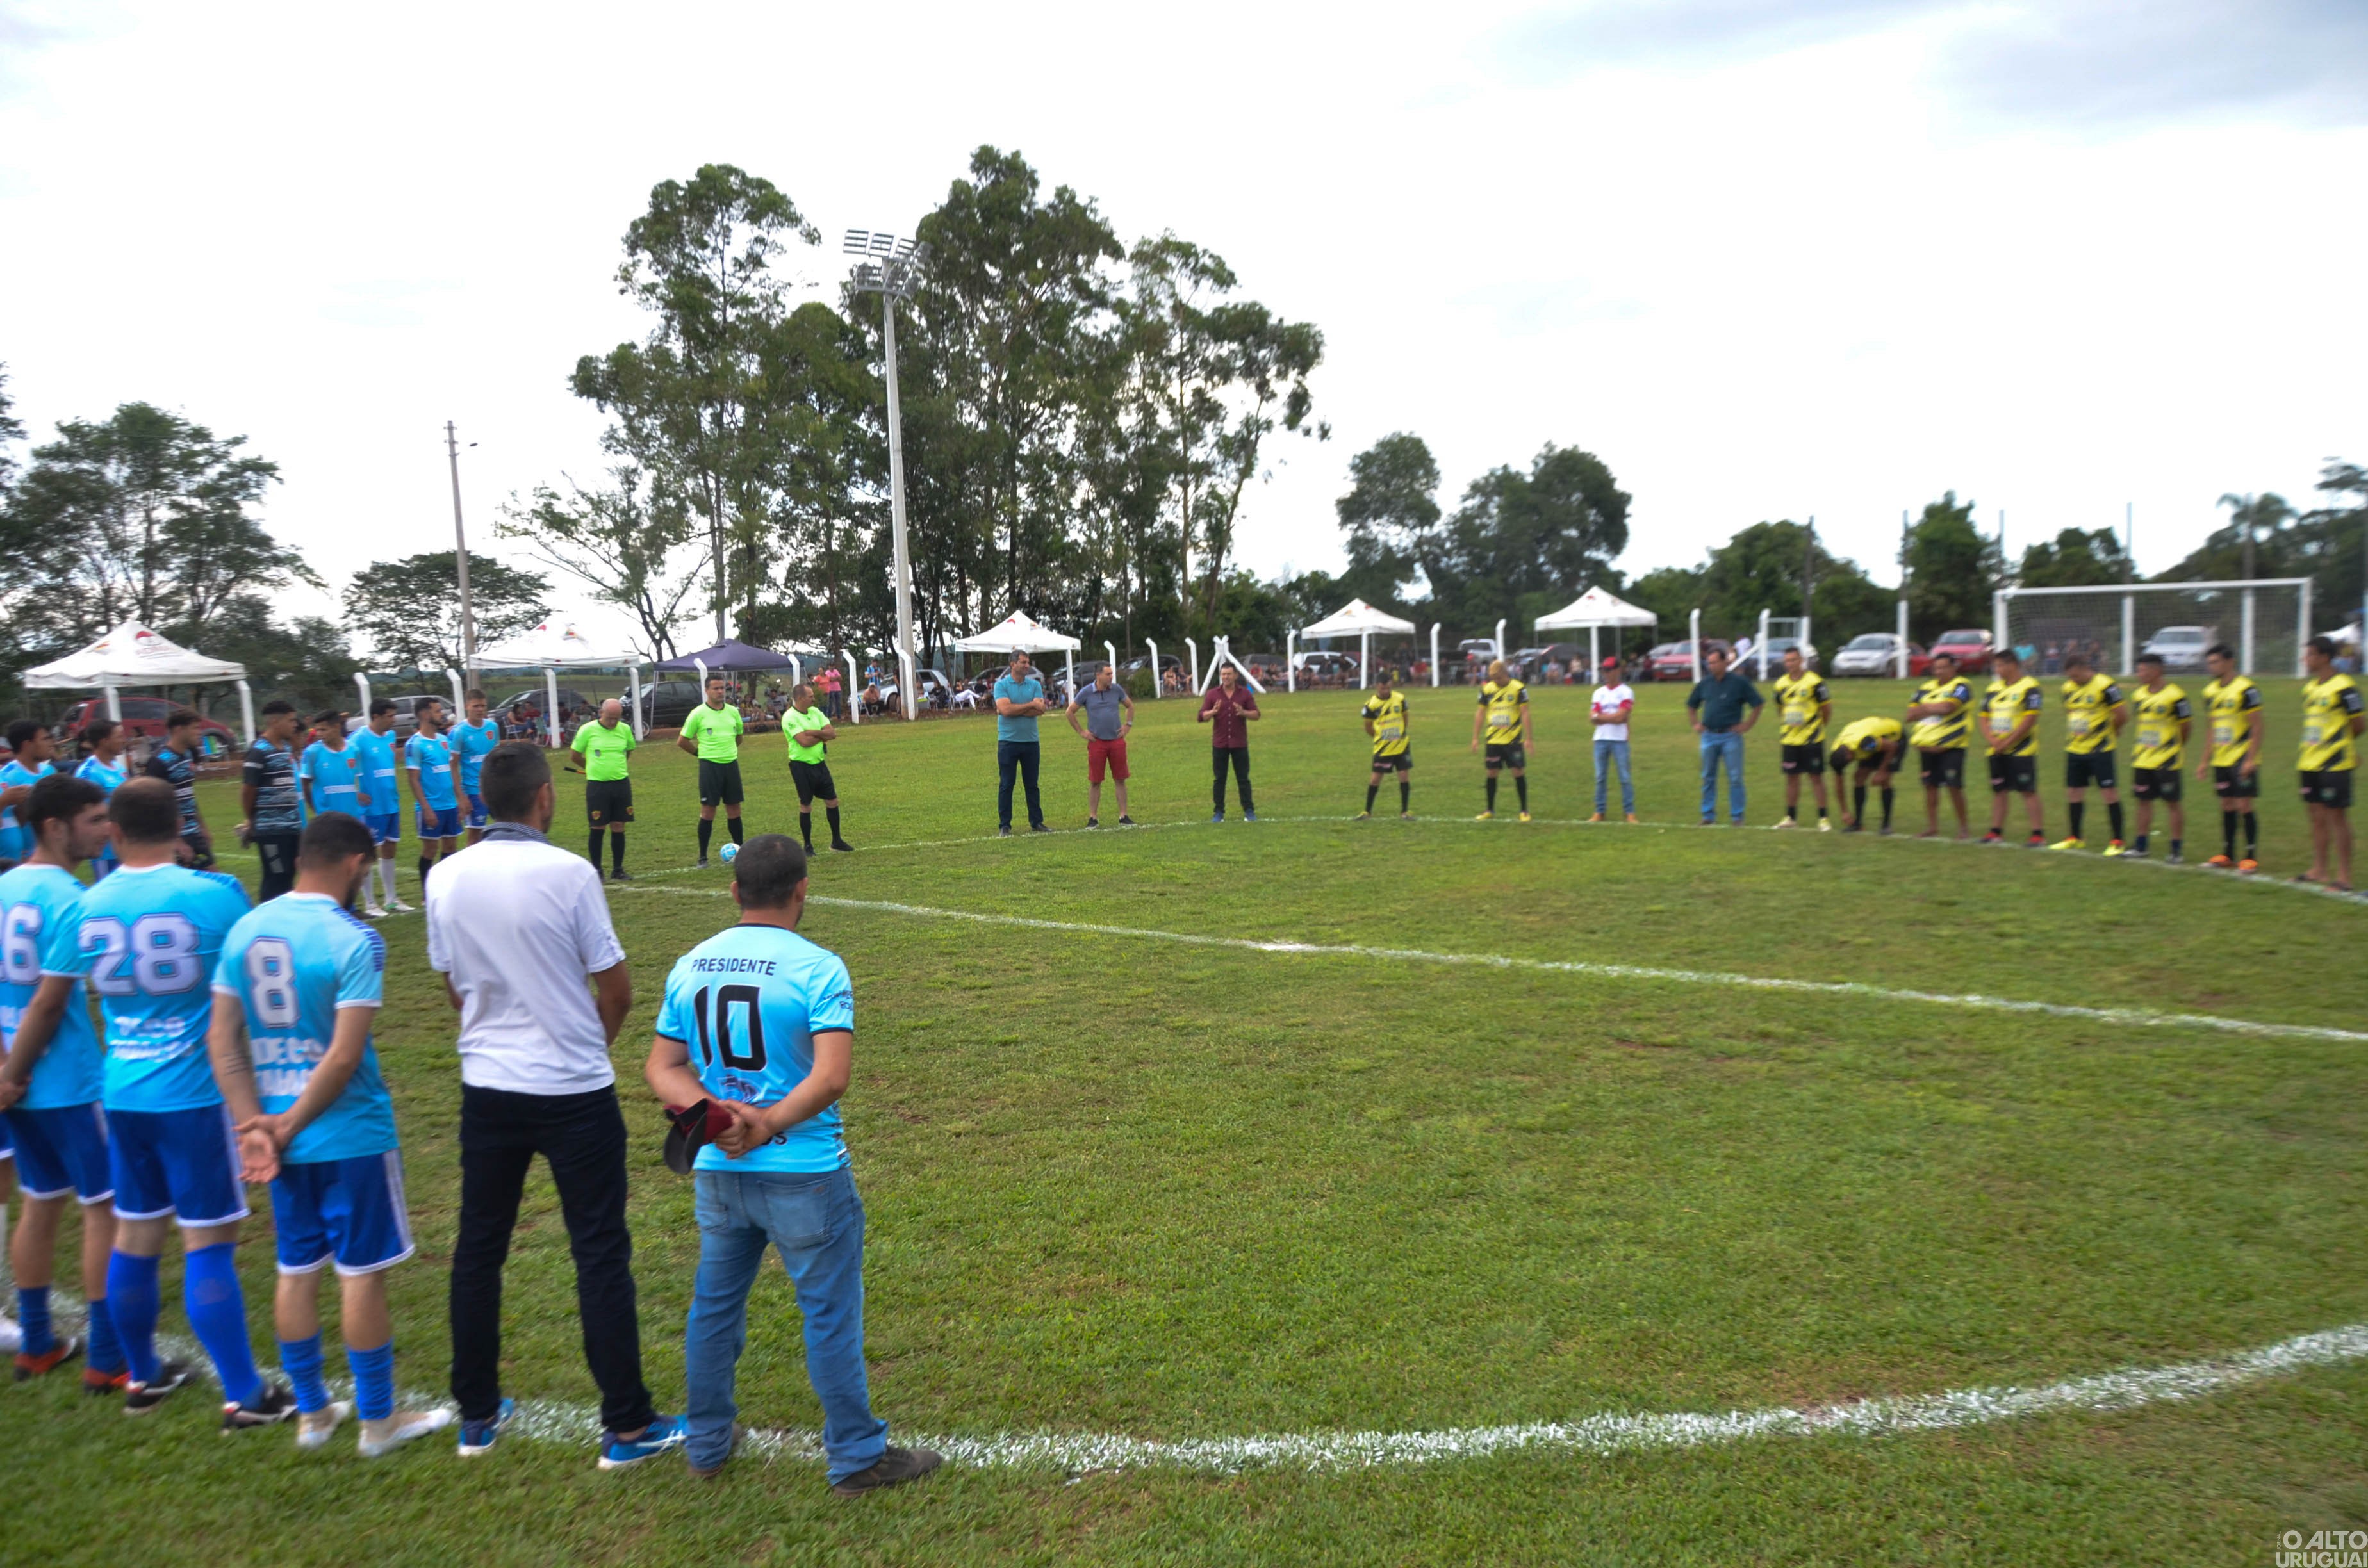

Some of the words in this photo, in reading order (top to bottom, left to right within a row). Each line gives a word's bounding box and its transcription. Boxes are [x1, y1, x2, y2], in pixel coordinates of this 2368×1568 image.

[78, 912, 204, 997] 28
[246, 936, 301, 1029] 8
[691, 958, 777, 976] PRESIDENTE
[694, 984, 768, 1073] 10
